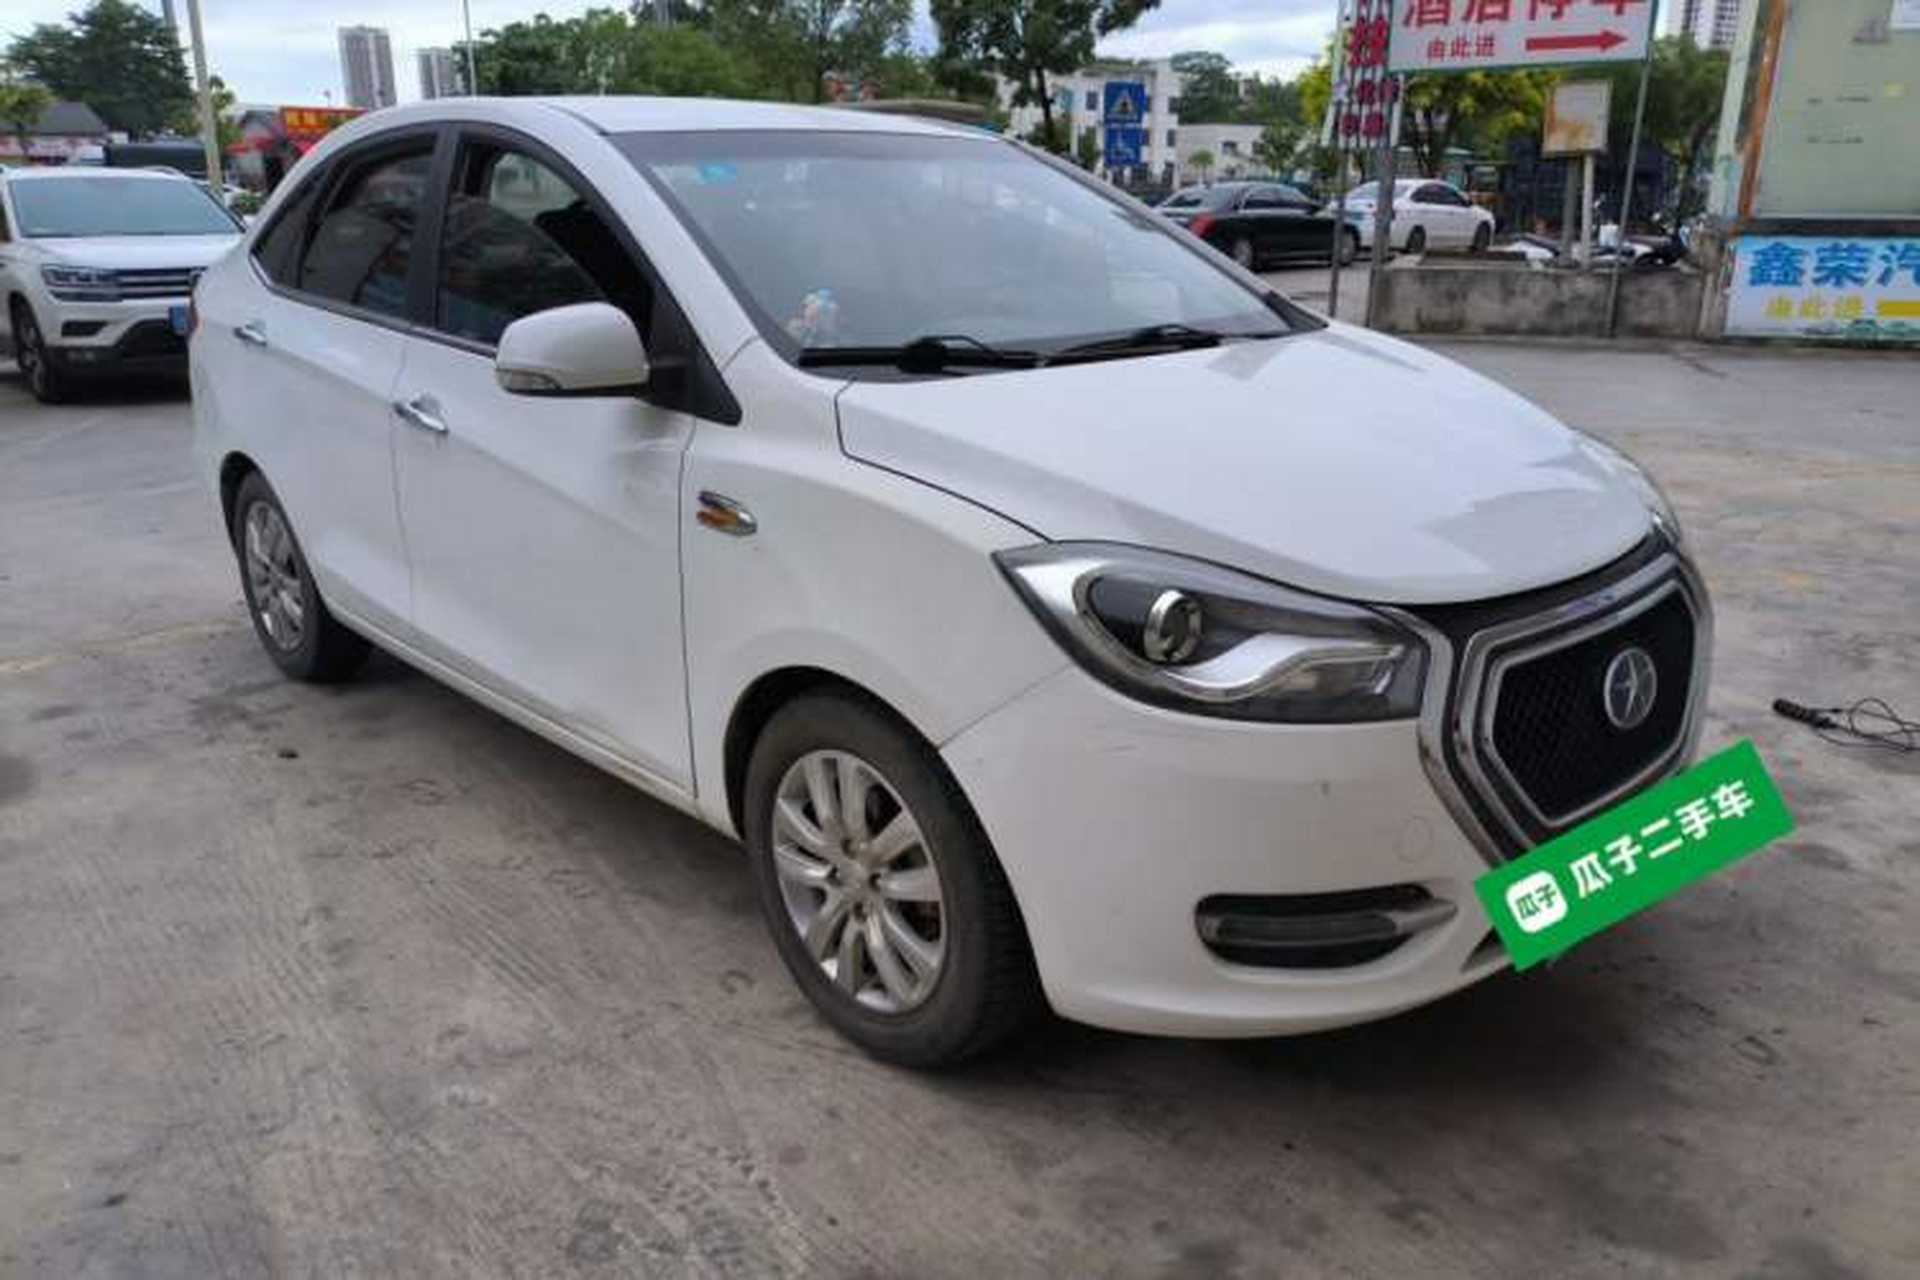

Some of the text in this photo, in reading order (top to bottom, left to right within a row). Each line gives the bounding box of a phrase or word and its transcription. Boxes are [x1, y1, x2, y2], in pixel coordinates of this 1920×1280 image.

[1427, 34, 1496, 61] 由此进
[1750, 241, 1920, 287] 鑫荣汽
